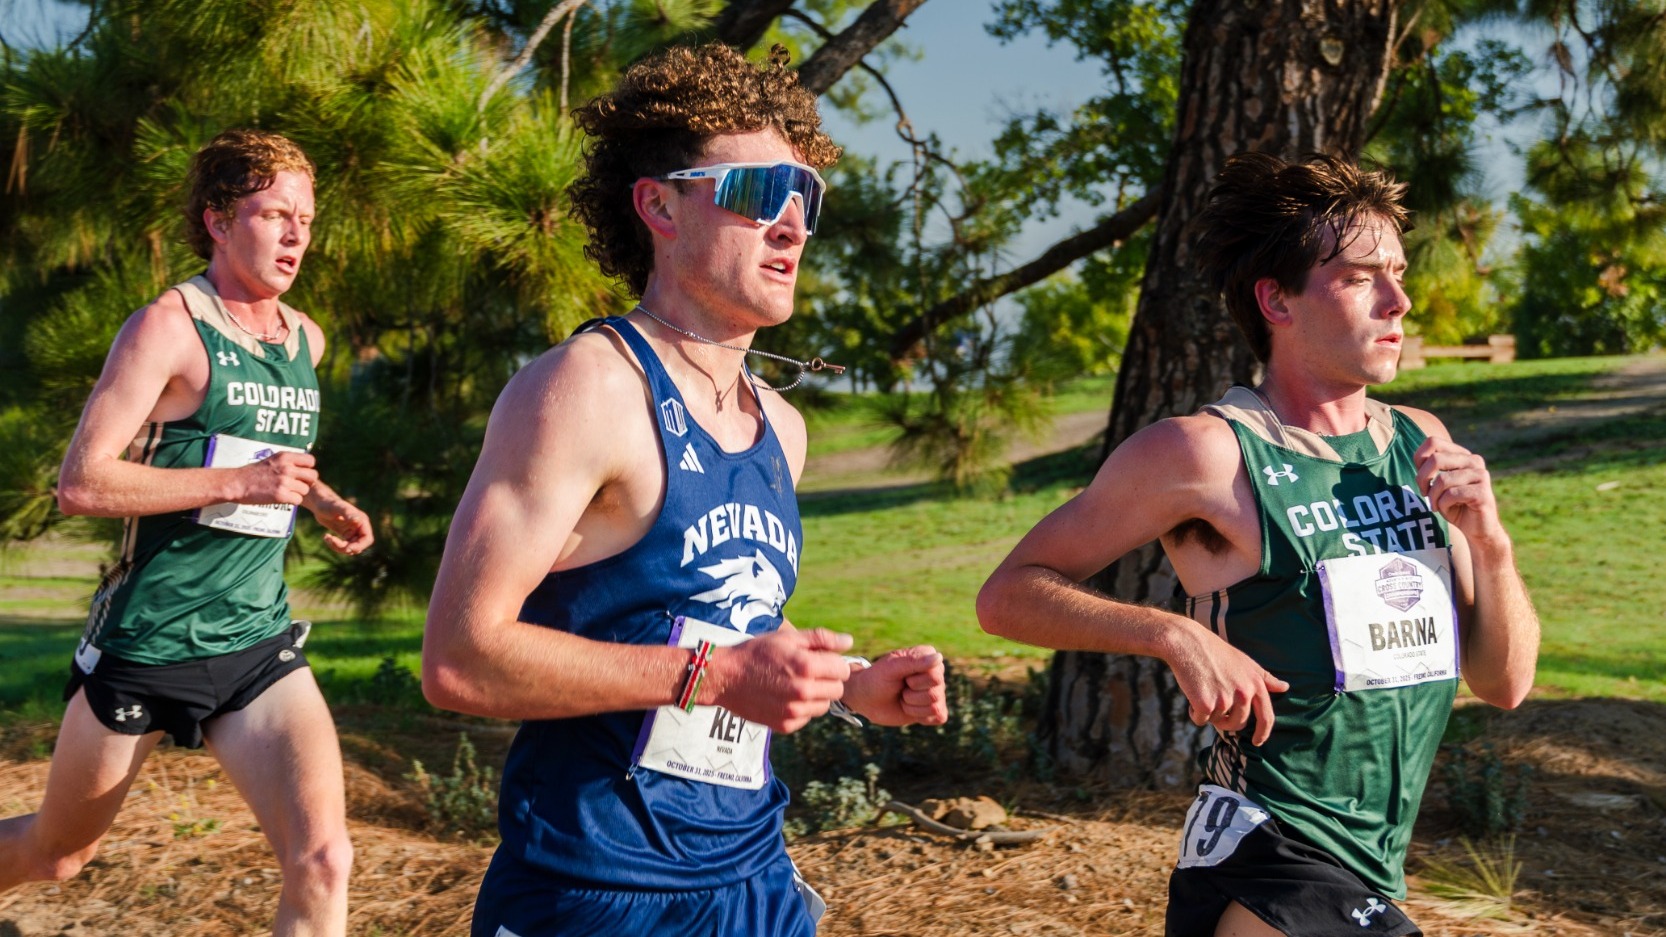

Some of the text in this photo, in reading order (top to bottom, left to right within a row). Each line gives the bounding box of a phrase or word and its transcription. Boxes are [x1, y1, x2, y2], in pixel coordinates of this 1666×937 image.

[255, 408, 311, 437] STATE
[1286, 485, 1438, 538] COLORA
[680, 502, 799, 578] NEVADA
[1341, 517, 1437, 558] STATE
[1368, 616, 1438, 652] BARNA
[1366, 677, 1391, 686] OCTOBER
[708, 706, 747, 744] KEY
[716, 745, 733, 755] NEVADA
[666, 760, 694, 773] OCTOBER
[702, 769, 715, 777] 2025
